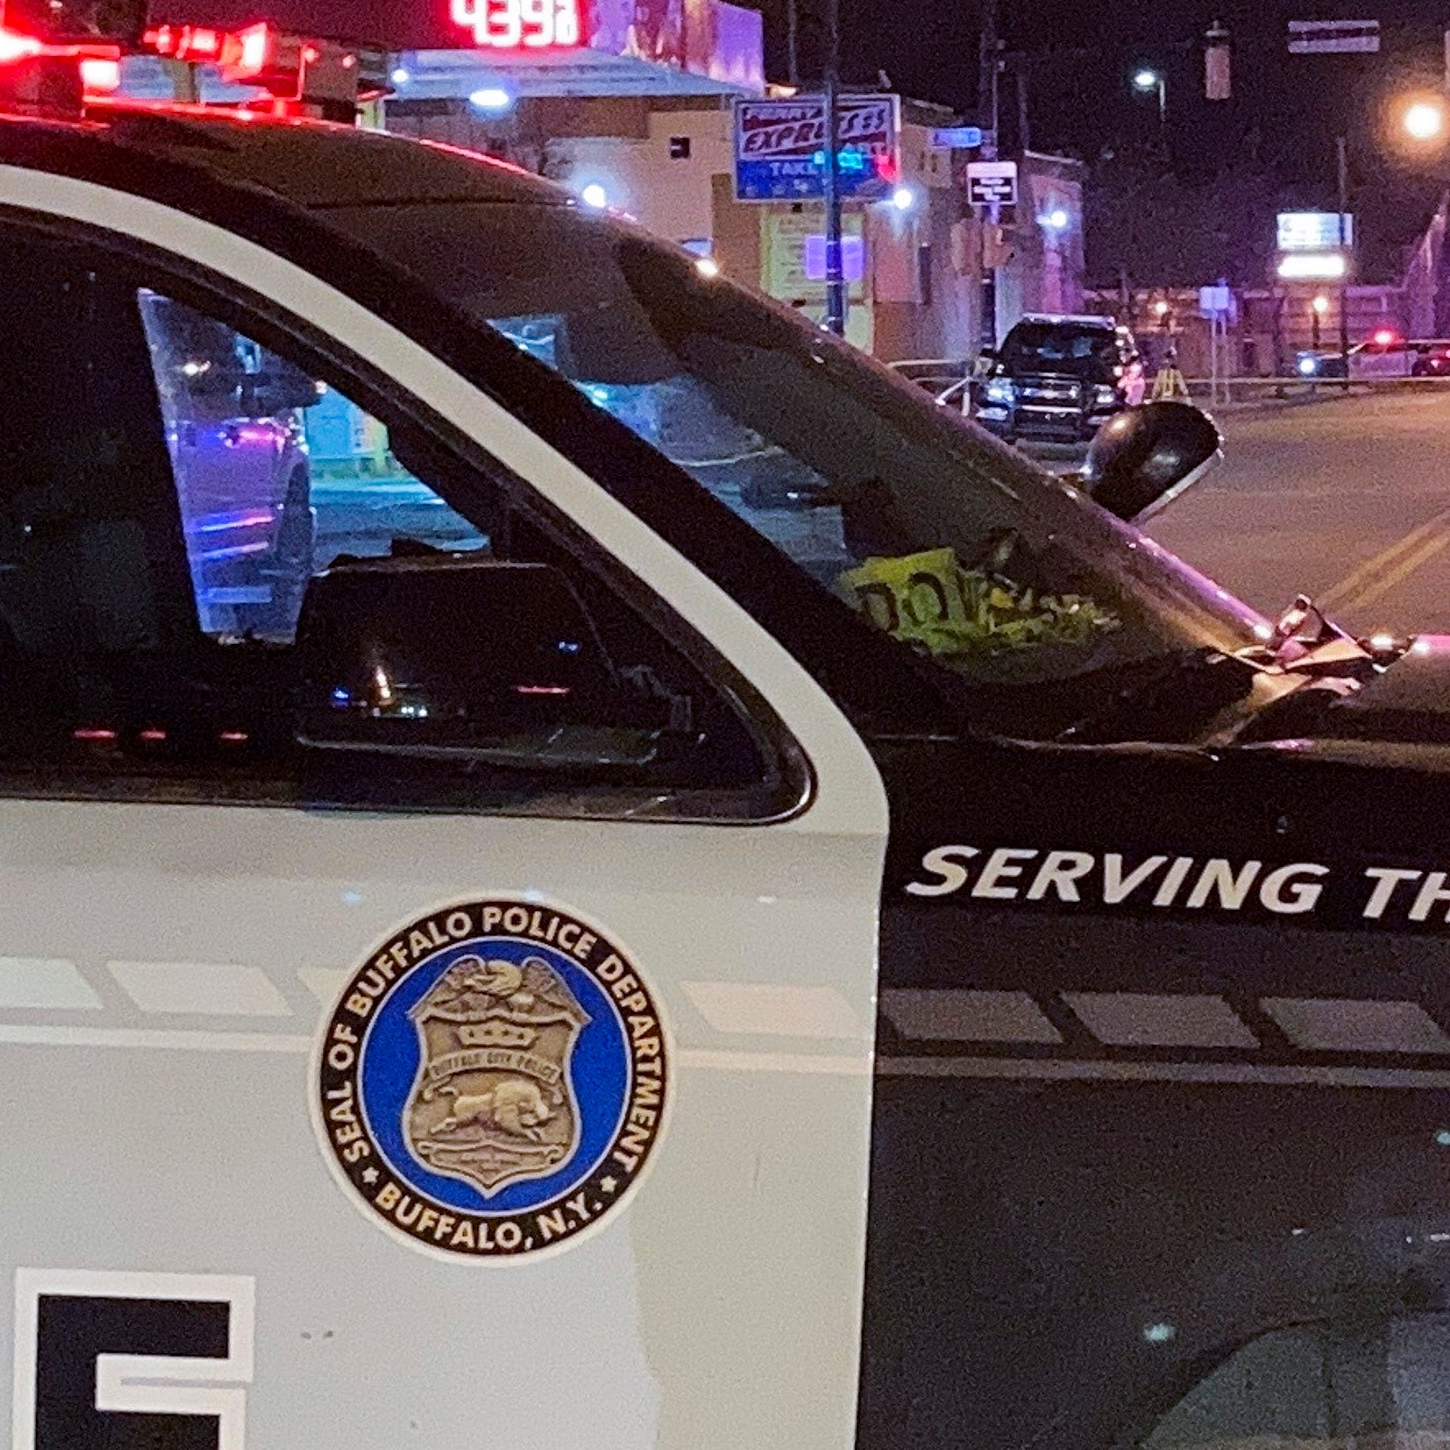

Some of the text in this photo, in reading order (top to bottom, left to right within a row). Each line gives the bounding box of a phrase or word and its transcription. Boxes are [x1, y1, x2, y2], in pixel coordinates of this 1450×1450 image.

[907, 844, 1328, 914] SERVING
[326, 906, 662, 1175] SEAL OF BUFFALO POLICE DEPARTMENT
[373, 1182, 604, 1252] BUFFALO, N.Y.
